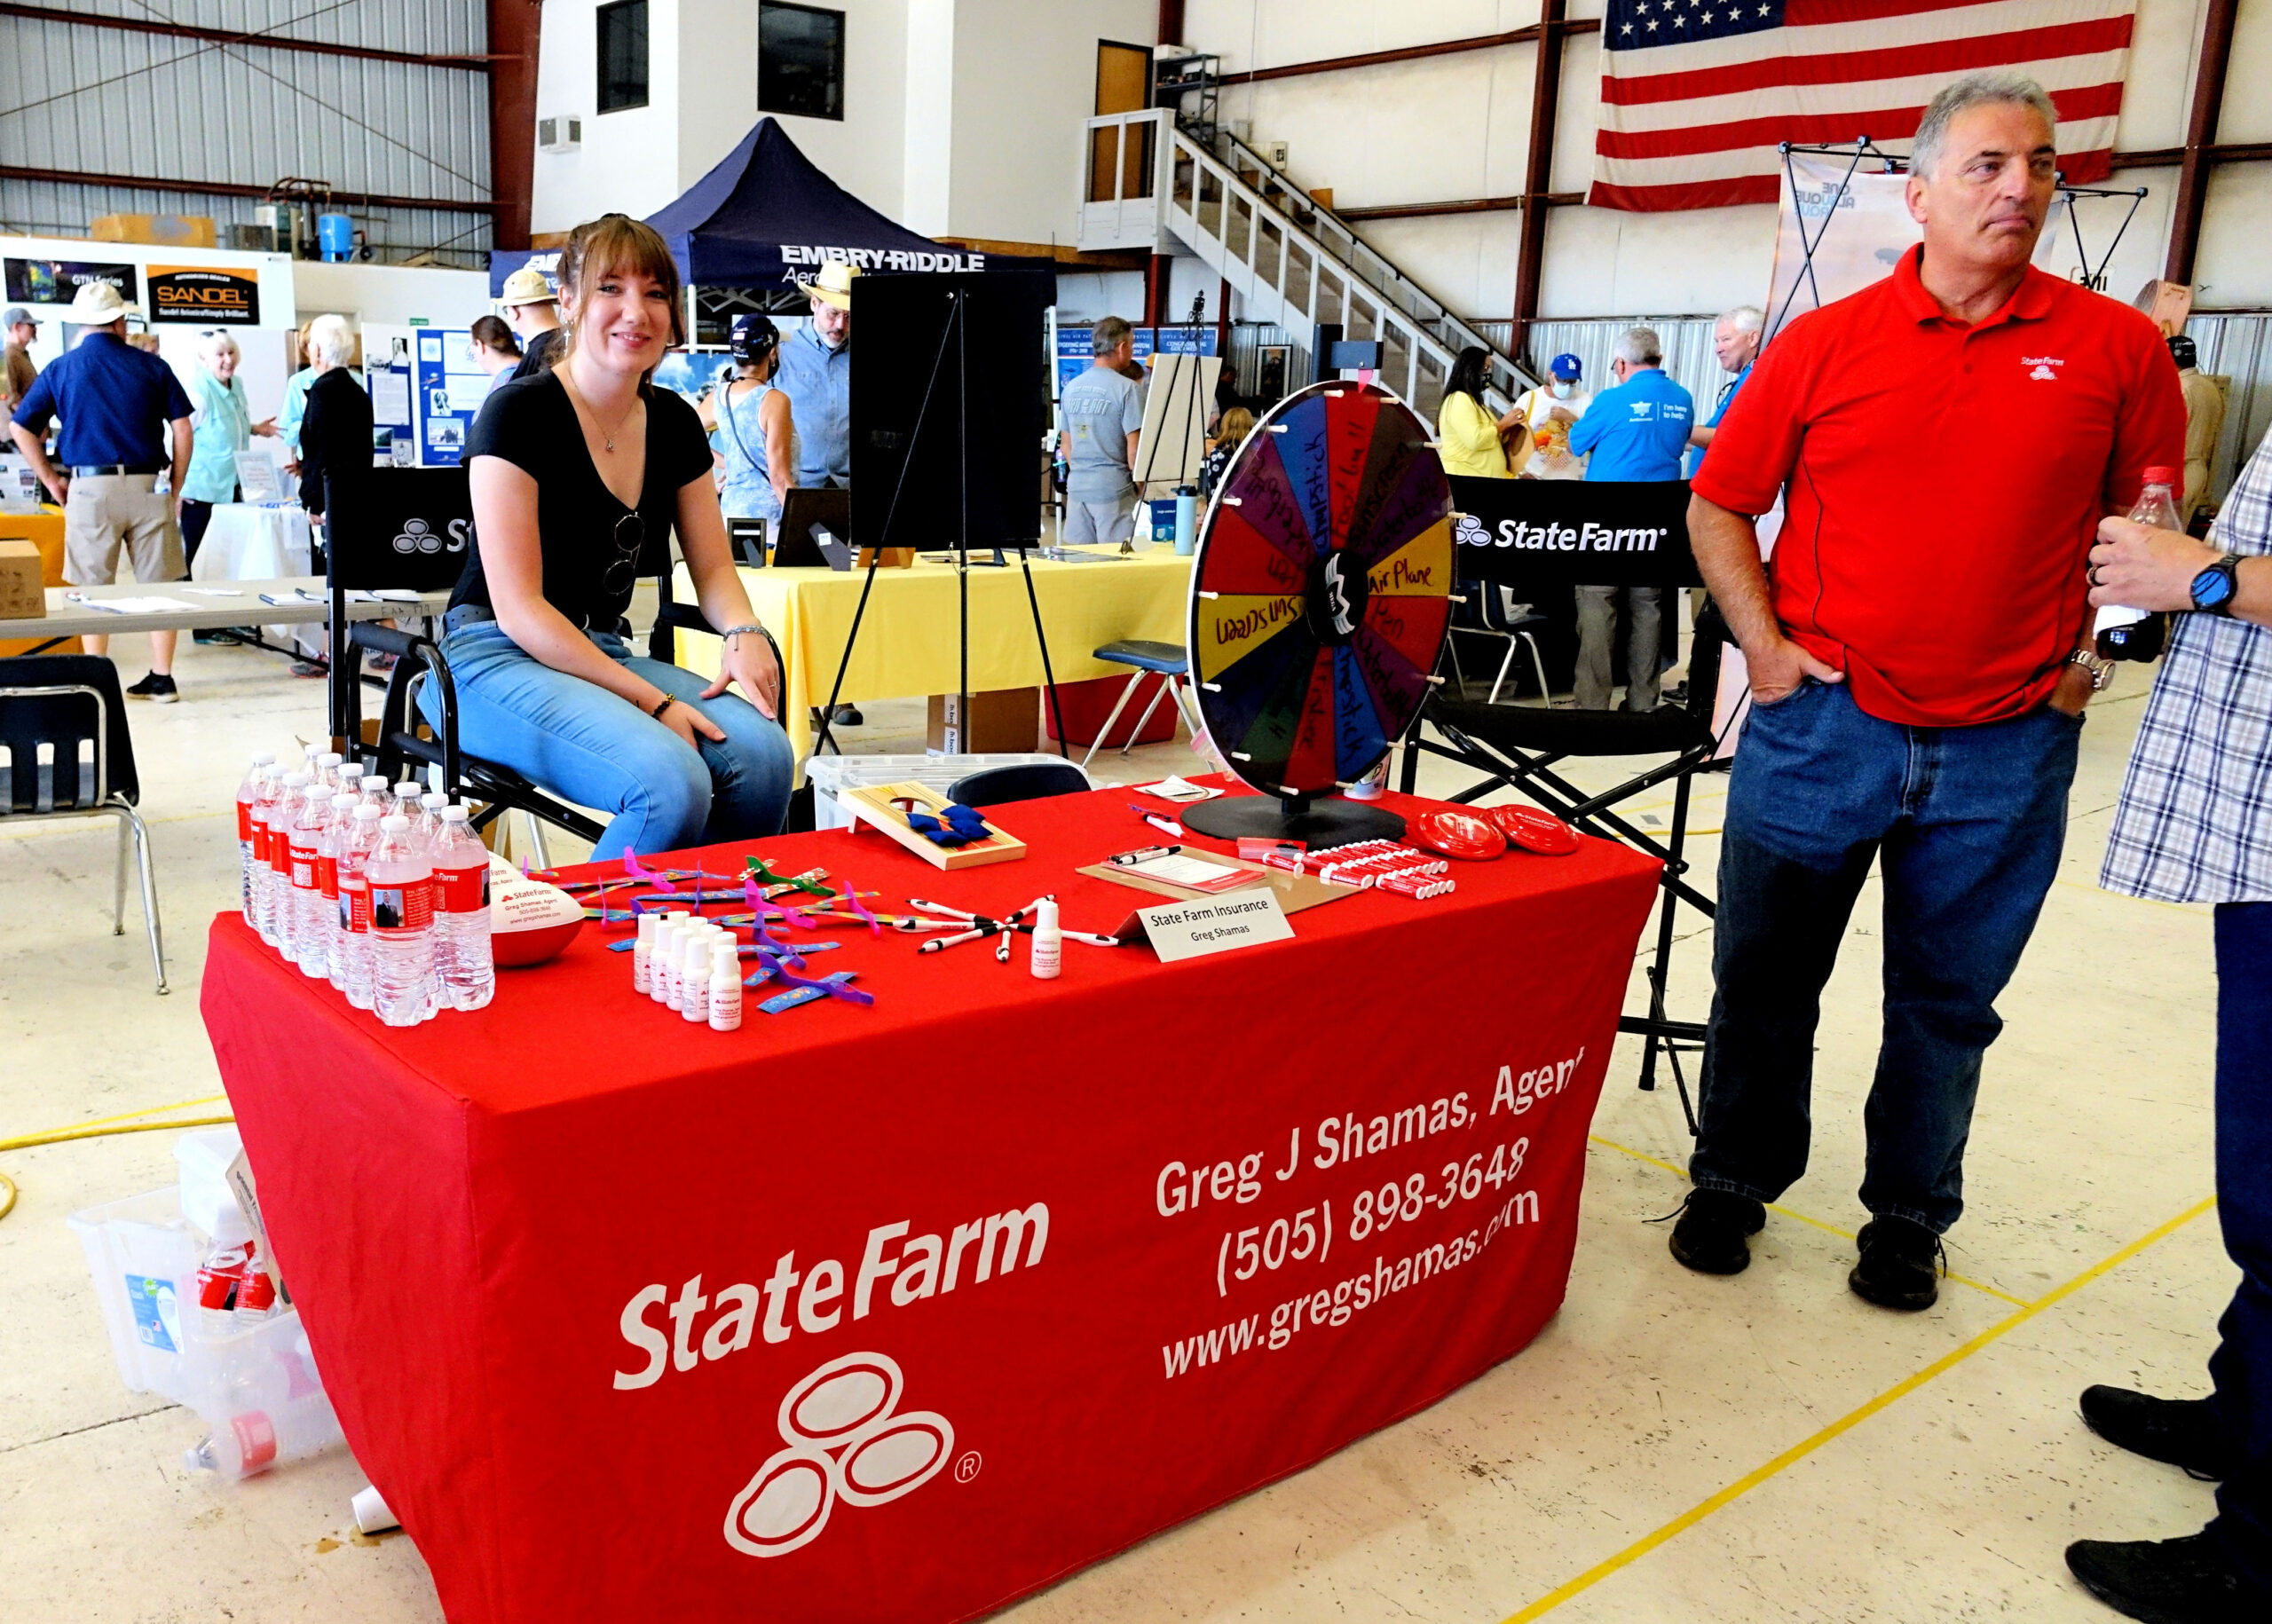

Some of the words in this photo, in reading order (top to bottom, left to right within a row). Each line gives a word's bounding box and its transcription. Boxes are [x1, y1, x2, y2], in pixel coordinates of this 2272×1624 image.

[780, 245, 985, 272] EMBRY-RIDDLE
[157, 286, 248, 304] SANDEL
[1150, 913, 1182, 927] State
[1183, 908, 1214, 922] Farm
[1214, 899, 1269, 917] Insurance
[1190, 931, 1215, 942] Greg
[1216, 924, 1250, 938] Shamas
[1156, 1150, 1265, 1218] Greg
[1275, 1127, 1301, 1181] J
[1313, 1091, 1477, 1170] Shamas,
[1216, 1200, 1333, 1298] (505)
[1349, 1137, 1530, 1242] 898-3648
[1162, 1189, 1540, 1380] www.gregshamas.com
